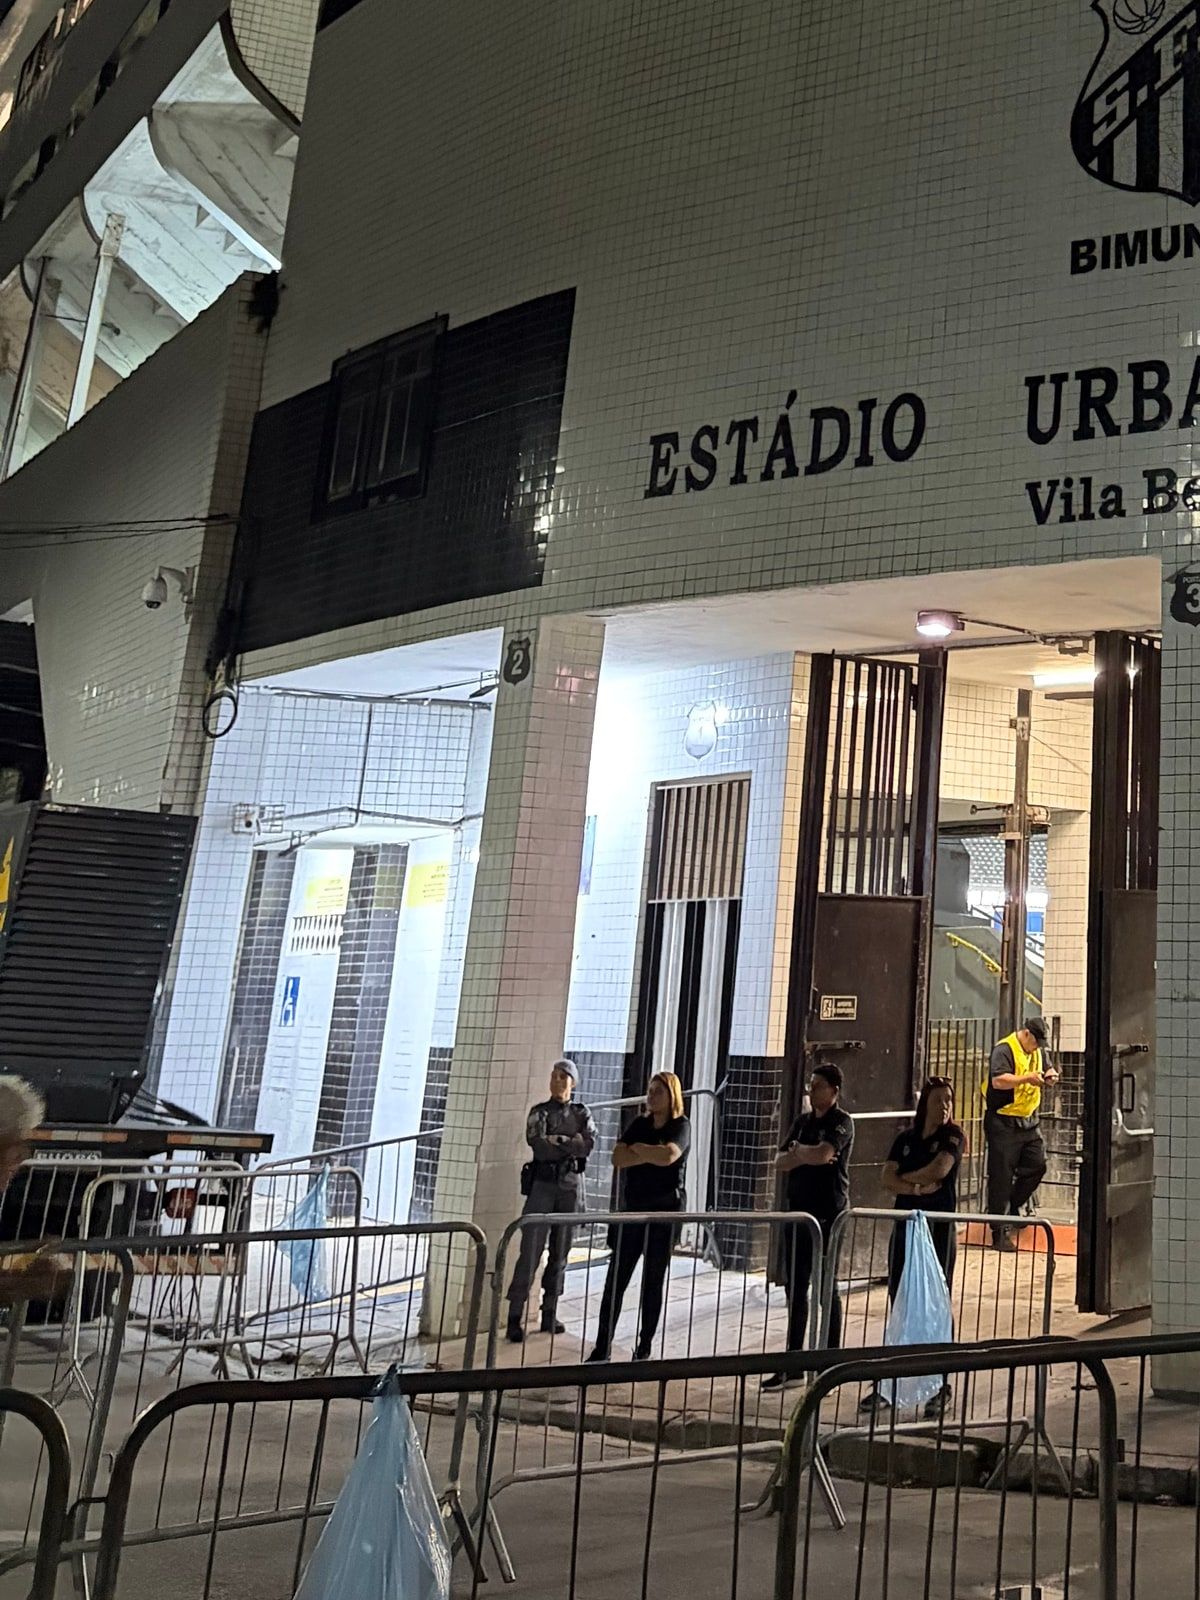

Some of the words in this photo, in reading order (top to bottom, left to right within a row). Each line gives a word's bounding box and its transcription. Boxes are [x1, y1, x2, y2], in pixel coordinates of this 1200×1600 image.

[645, 390, 926, 499] ESTÁDIO
[1026, 477, 1126, 527] Vila
[512, 650, 523, 675] 2
